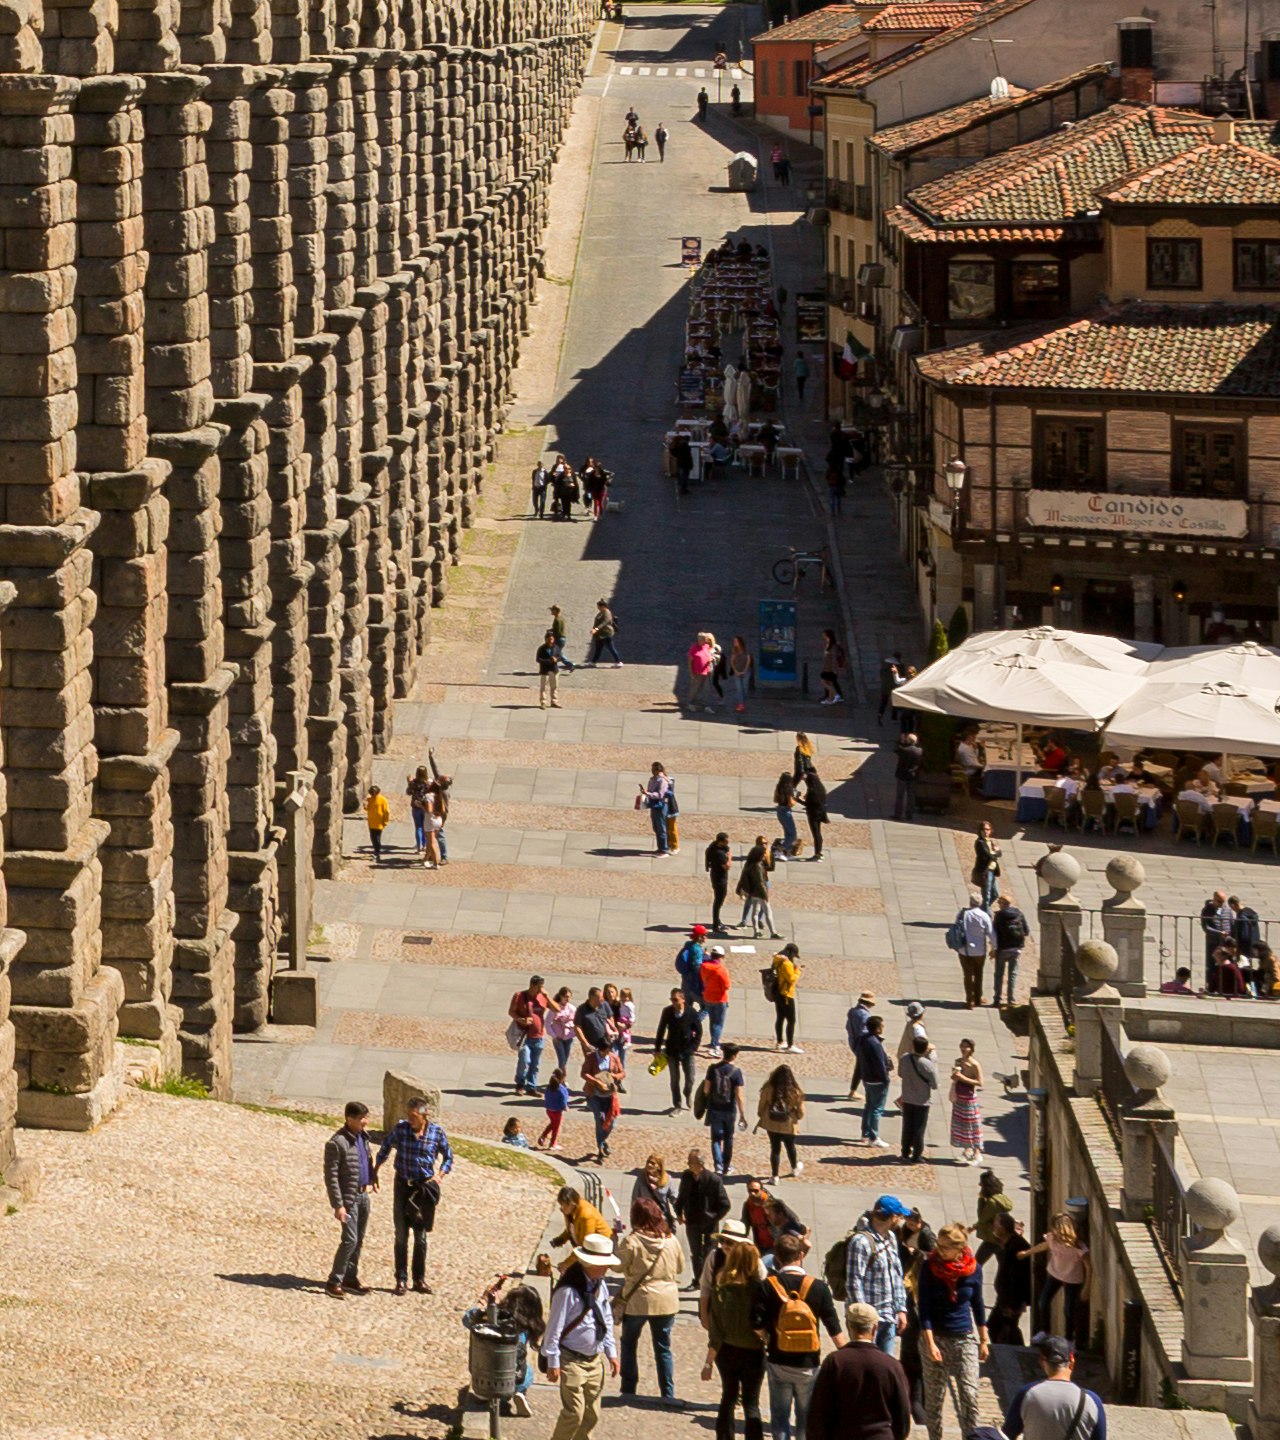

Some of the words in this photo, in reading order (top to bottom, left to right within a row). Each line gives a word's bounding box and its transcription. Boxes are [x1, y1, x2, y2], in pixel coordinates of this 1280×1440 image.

[1109, 514, 1154, 529] Mayor
[1159, 519, 1174, 529] de
[1178, 518, 1227, 531] Castilla
